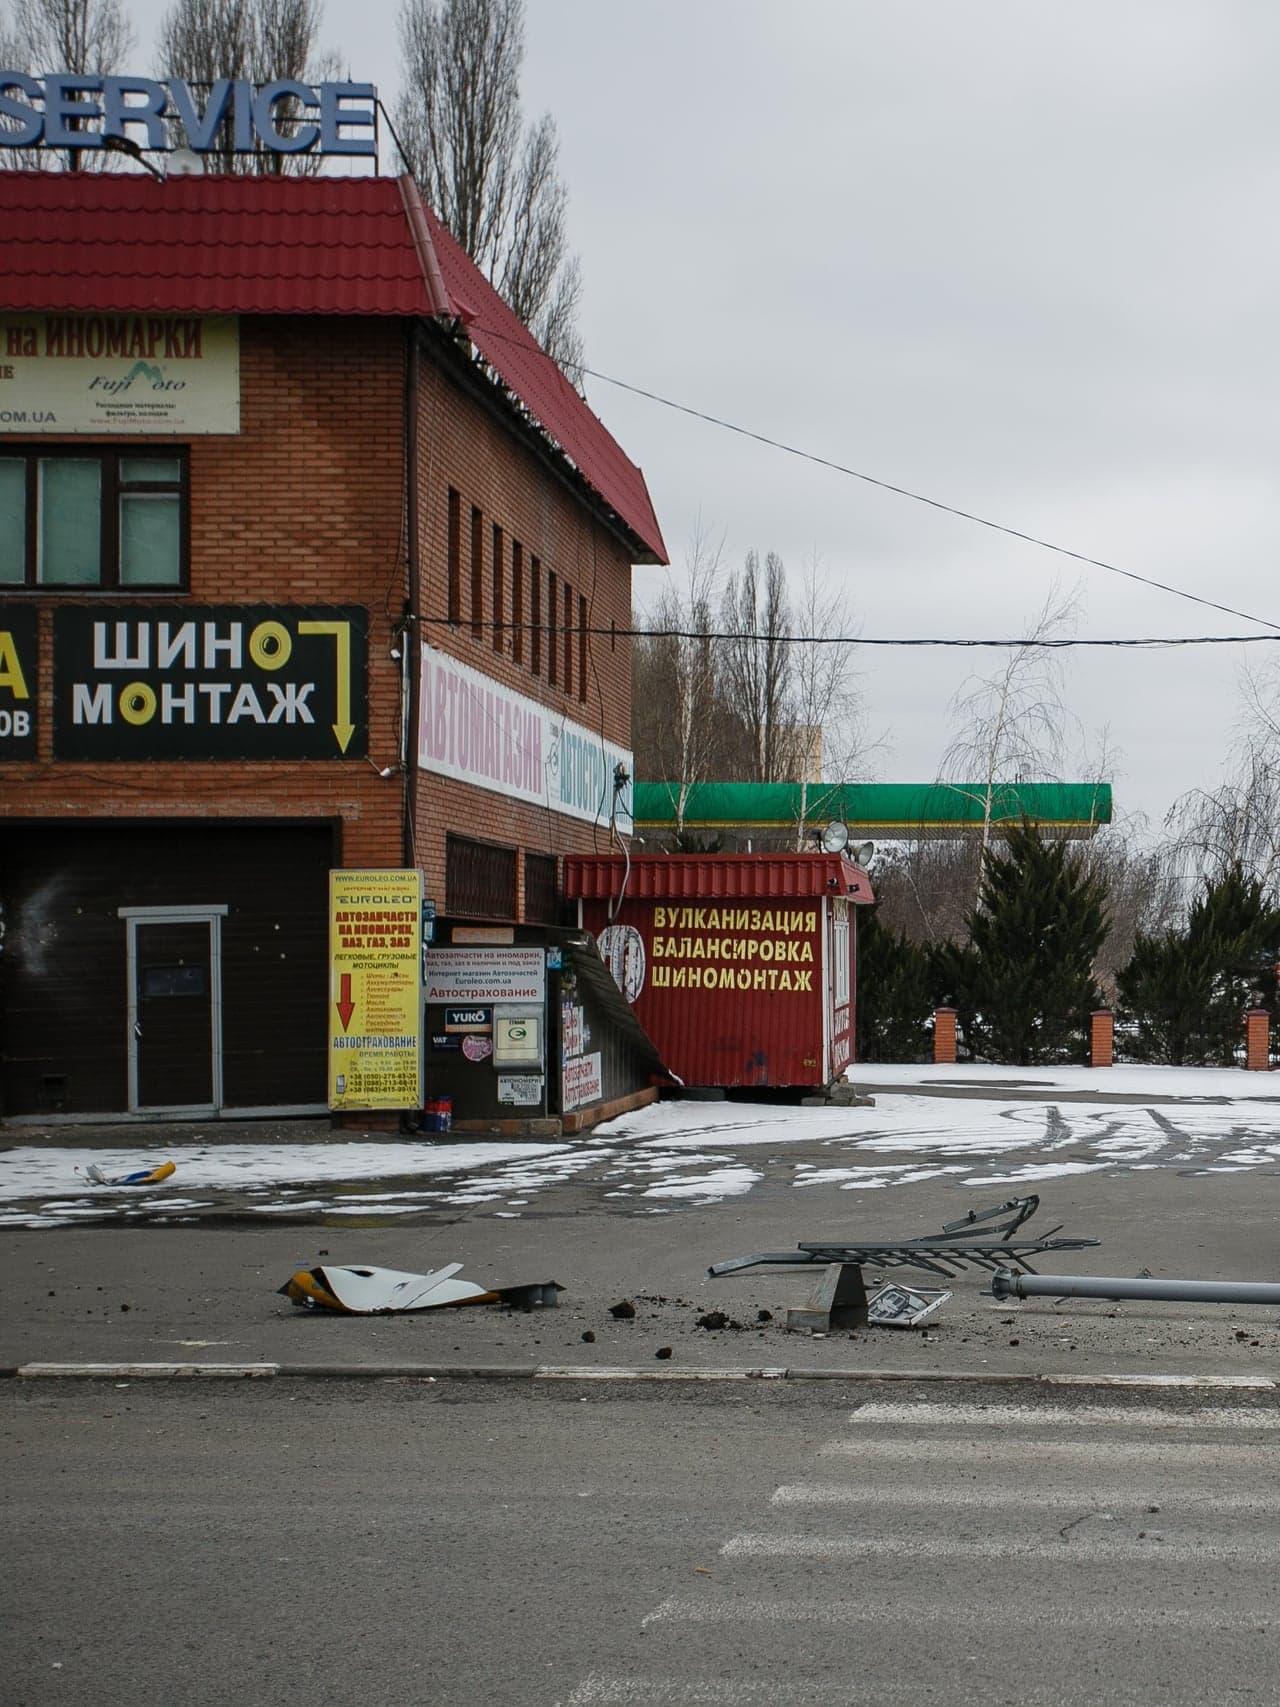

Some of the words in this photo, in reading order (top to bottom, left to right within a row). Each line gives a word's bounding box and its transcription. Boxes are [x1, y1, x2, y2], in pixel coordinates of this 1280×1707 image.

[0, 71, 376, 154] SERVICE
[7, 327, 38, 357] на
[45, 318, 203, 359] ИНОМАРКИ
[94, 621, 292, 671] ШИНО
[73, 682, 314, 725] МОНТАЖ
[421, 661, 541, 795] АВТОМАГАЗИН
[336, 911, 417, 922] АВТОЗАПЧАСТИ
[654, 907, 816, 935] ВУЛКАНИЗАЦИЯ
[425, 952, 482, 960] Автозапчасти
[496, 952, 542, 960] иномарки,
[652, 937, 814, 962] БАЛАНСИРОВКА
[651, 966, 812, 992] ШИНОМОНТАЖ
[430, 988, 537, 999] Автострахование
[334, 1036, 417, 1048] АВТОСТРАХОВАНИЕ
